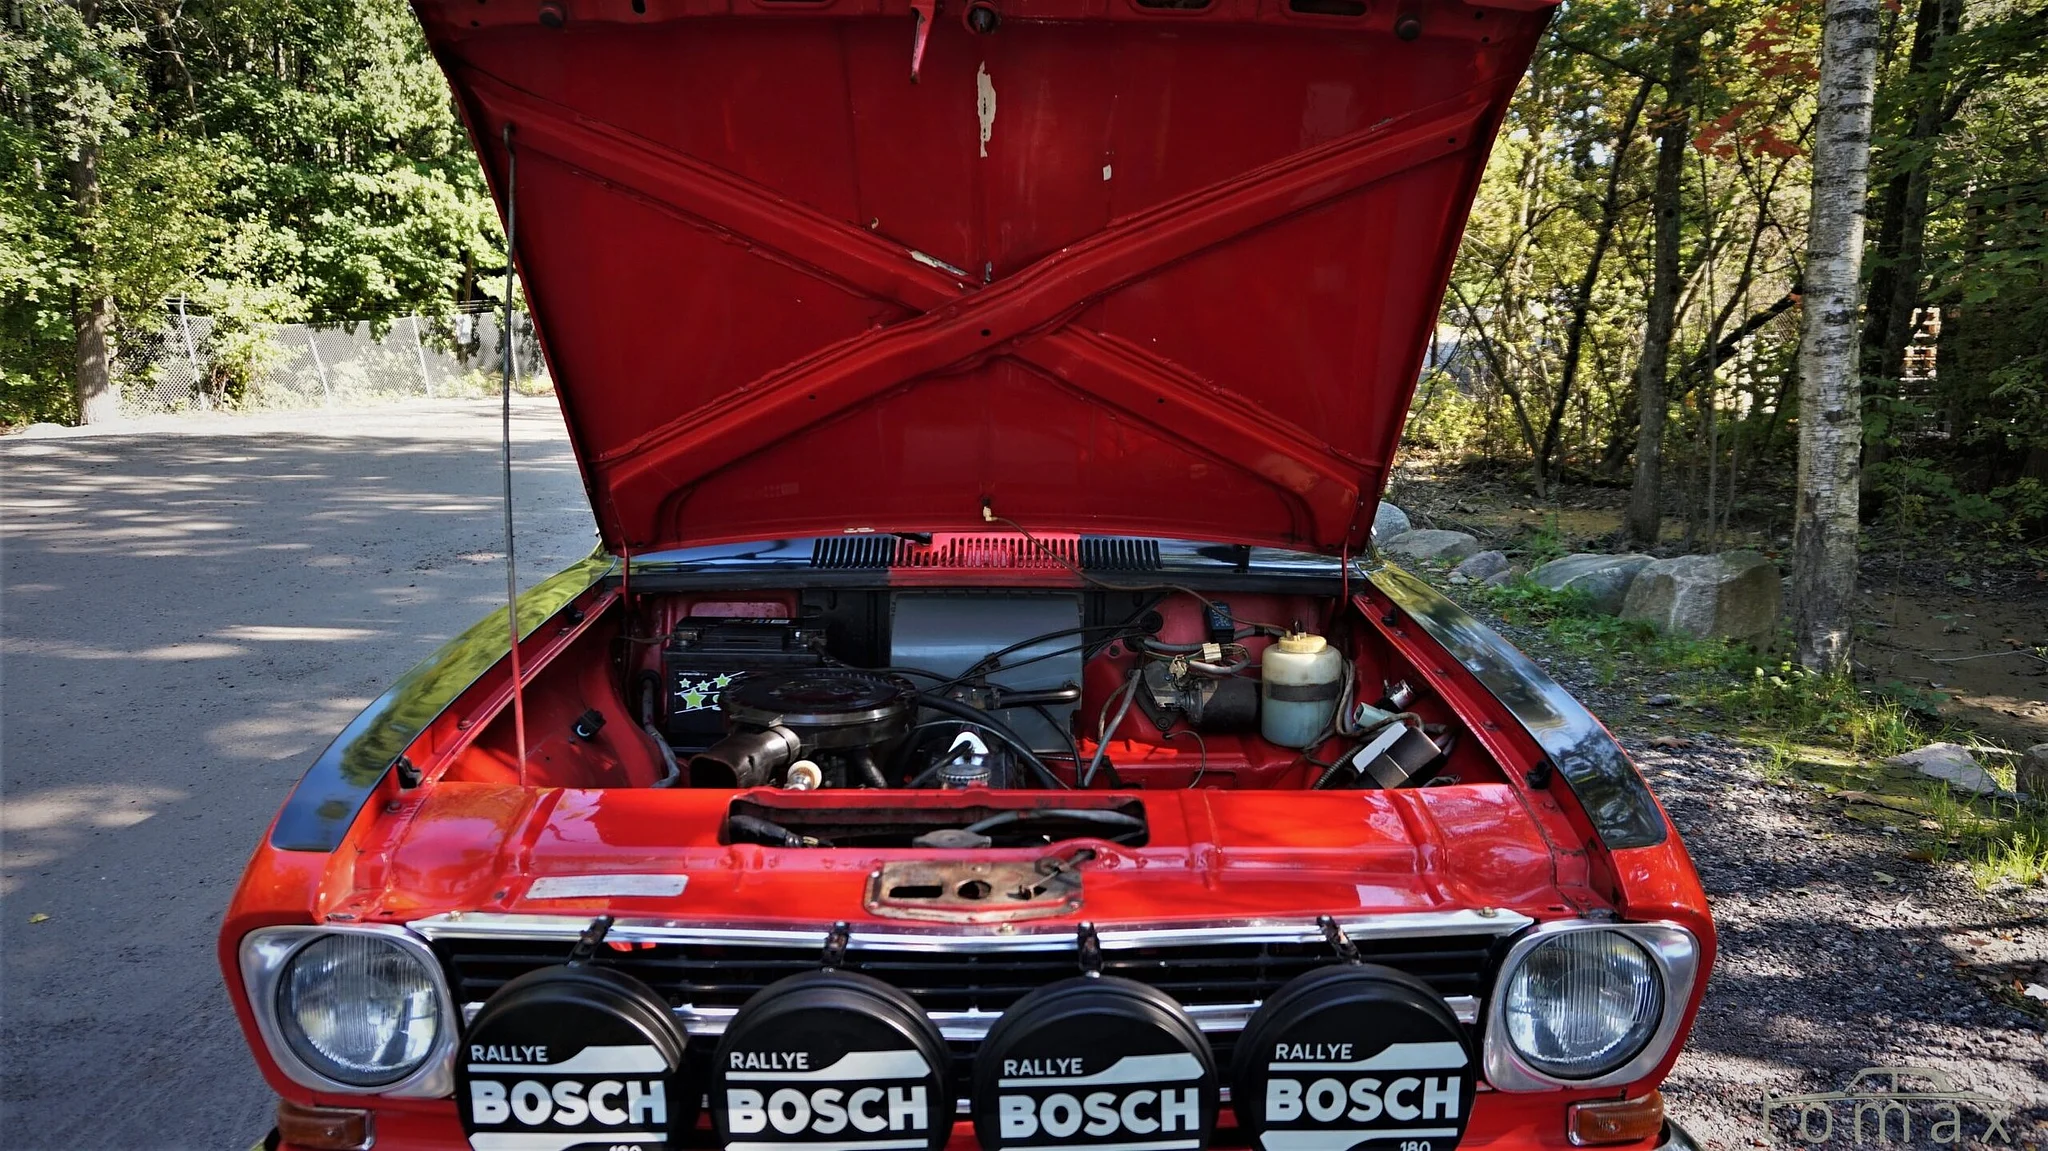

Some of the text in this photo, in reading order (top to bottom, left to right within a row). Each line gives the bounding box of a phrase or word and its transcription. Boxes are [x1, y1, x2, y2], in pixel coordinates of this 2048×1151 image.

[470, 1044, 548, 1063] RALLYE
[730, 1051, 809, 1070] RALLYE
[1004, 1057, 1083, 1076] RALLYE
[1275, 1043, 1353, 1060] RALLYE
[469, 1080, 667, 1126] BOSCH
[726, 1085, 928, 1134] BOSCH
[998, 1087, 1200, 1139] BOSCH
[1265, 1076, 1461, 1122] BOSCH
